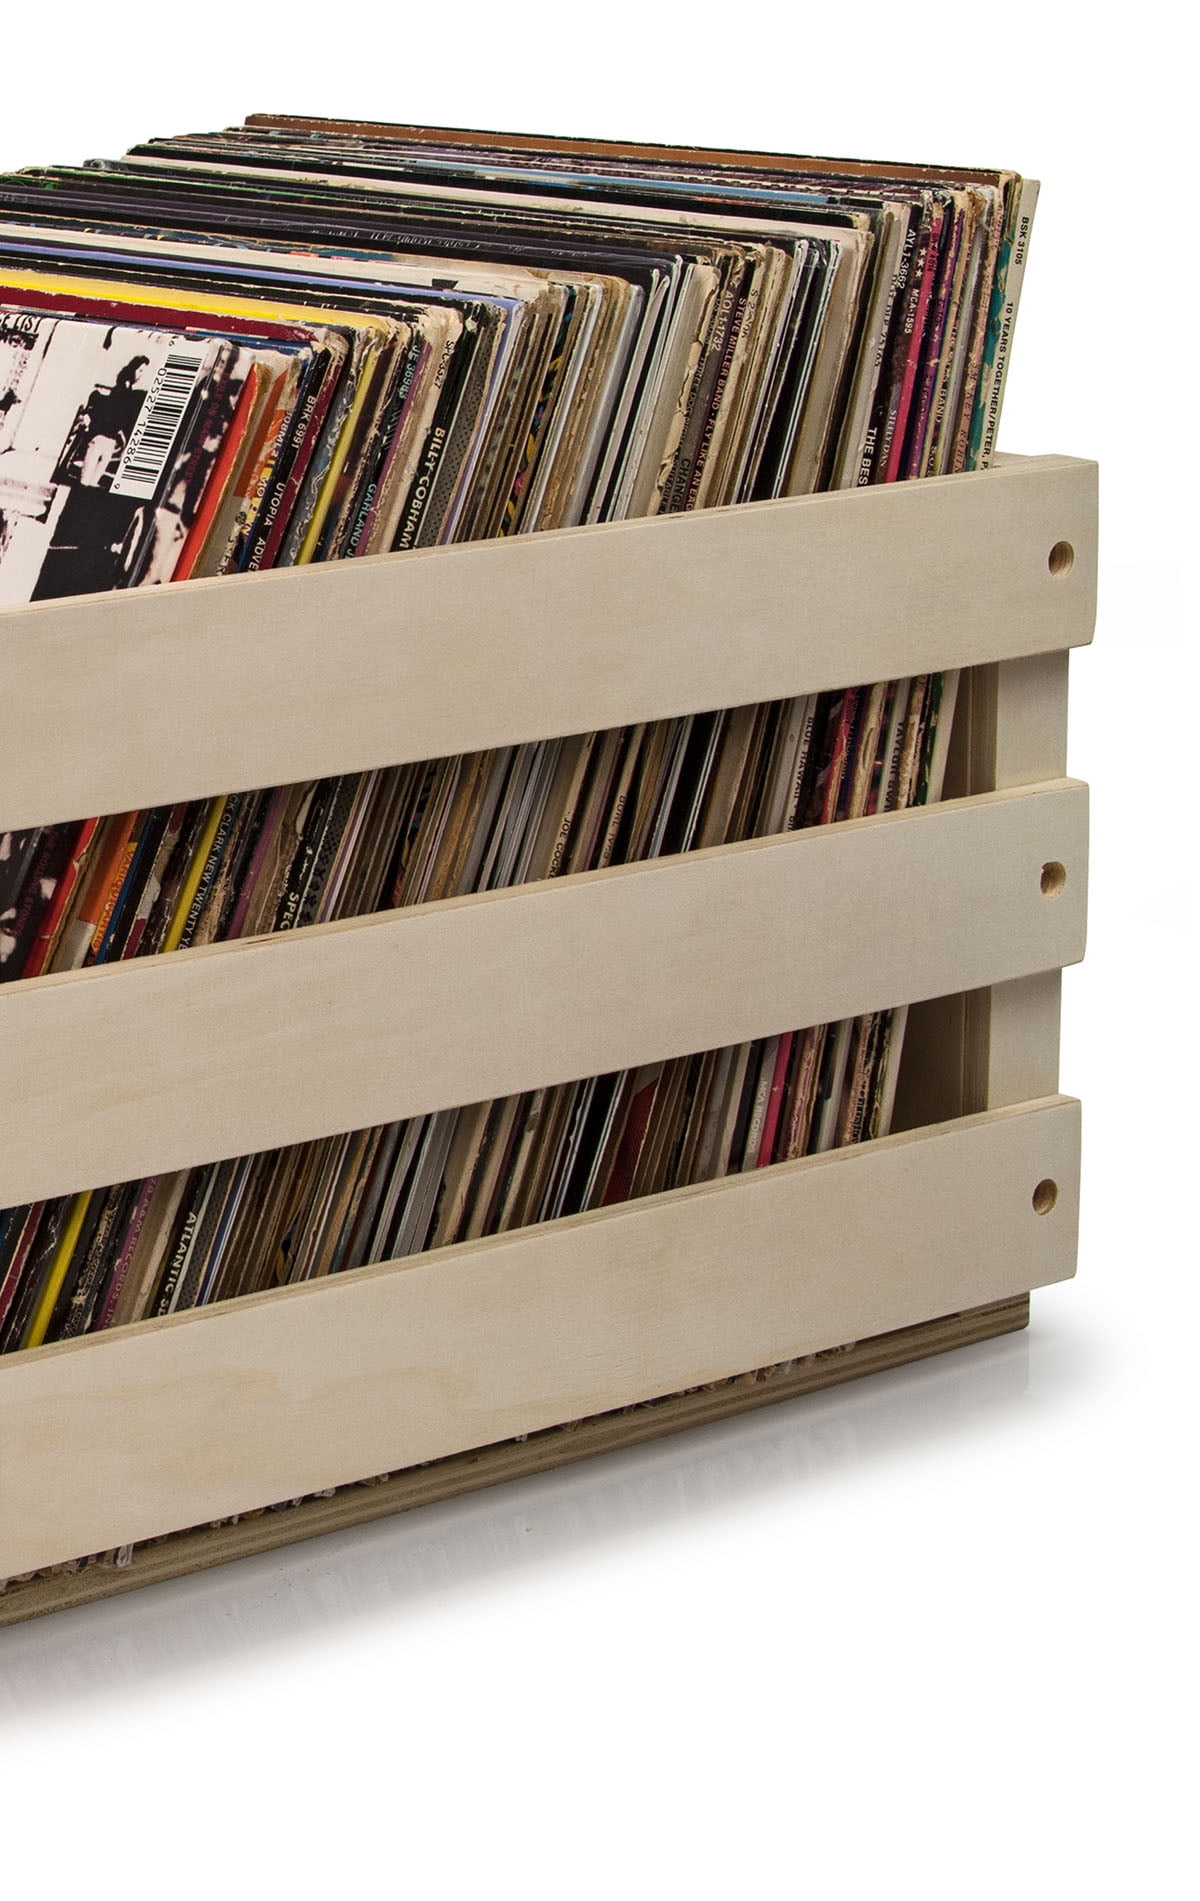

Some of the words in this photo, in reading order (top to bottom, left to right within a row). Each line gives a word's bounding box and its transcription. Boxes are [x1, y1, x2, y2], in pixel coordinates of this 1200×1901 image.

[1018, 216, 1029, 239] BSK
[1014, 240, 1025, 264] 3105
[731, 296, 747, 334] STEVE
[1005, 301, 1013, 314] 10
[999, 317, 1011, 352] YEARS
[408, 344, 420, 361] JE
[720, 334, 737, 376] MILLER
[141, 366, 167, 412] 02527
[711, 378, 725, 409] BAND
[300, 394, 315, 421] BRK
[290, 421, 306, 449] 6991
[704, 418, 716, 438] FLY
[864, 426, 877, 454] THE
[121, 421, 146, 466] 14286
[422, 426, 445, 472] BILLY
[696, 442, 709, 467] LIKE
[691, 469, 702, 485] AN
[980, 461, 988, 471] P
[112, 482, 120, 490] 9
[263, 481, 285, 528] UTOPIA
[348, 483, 378, 546] GARLAND
[398, 474, 430, 549] COBHAM
[211, 812, 232, 853] CLARK
[559, 817, 571, 838] JOE
[200, 854, 217, 883] NEW
[183, 884, 207, 934] TWENTY
[164, 1211, 198, 1293] ATLANTIC
